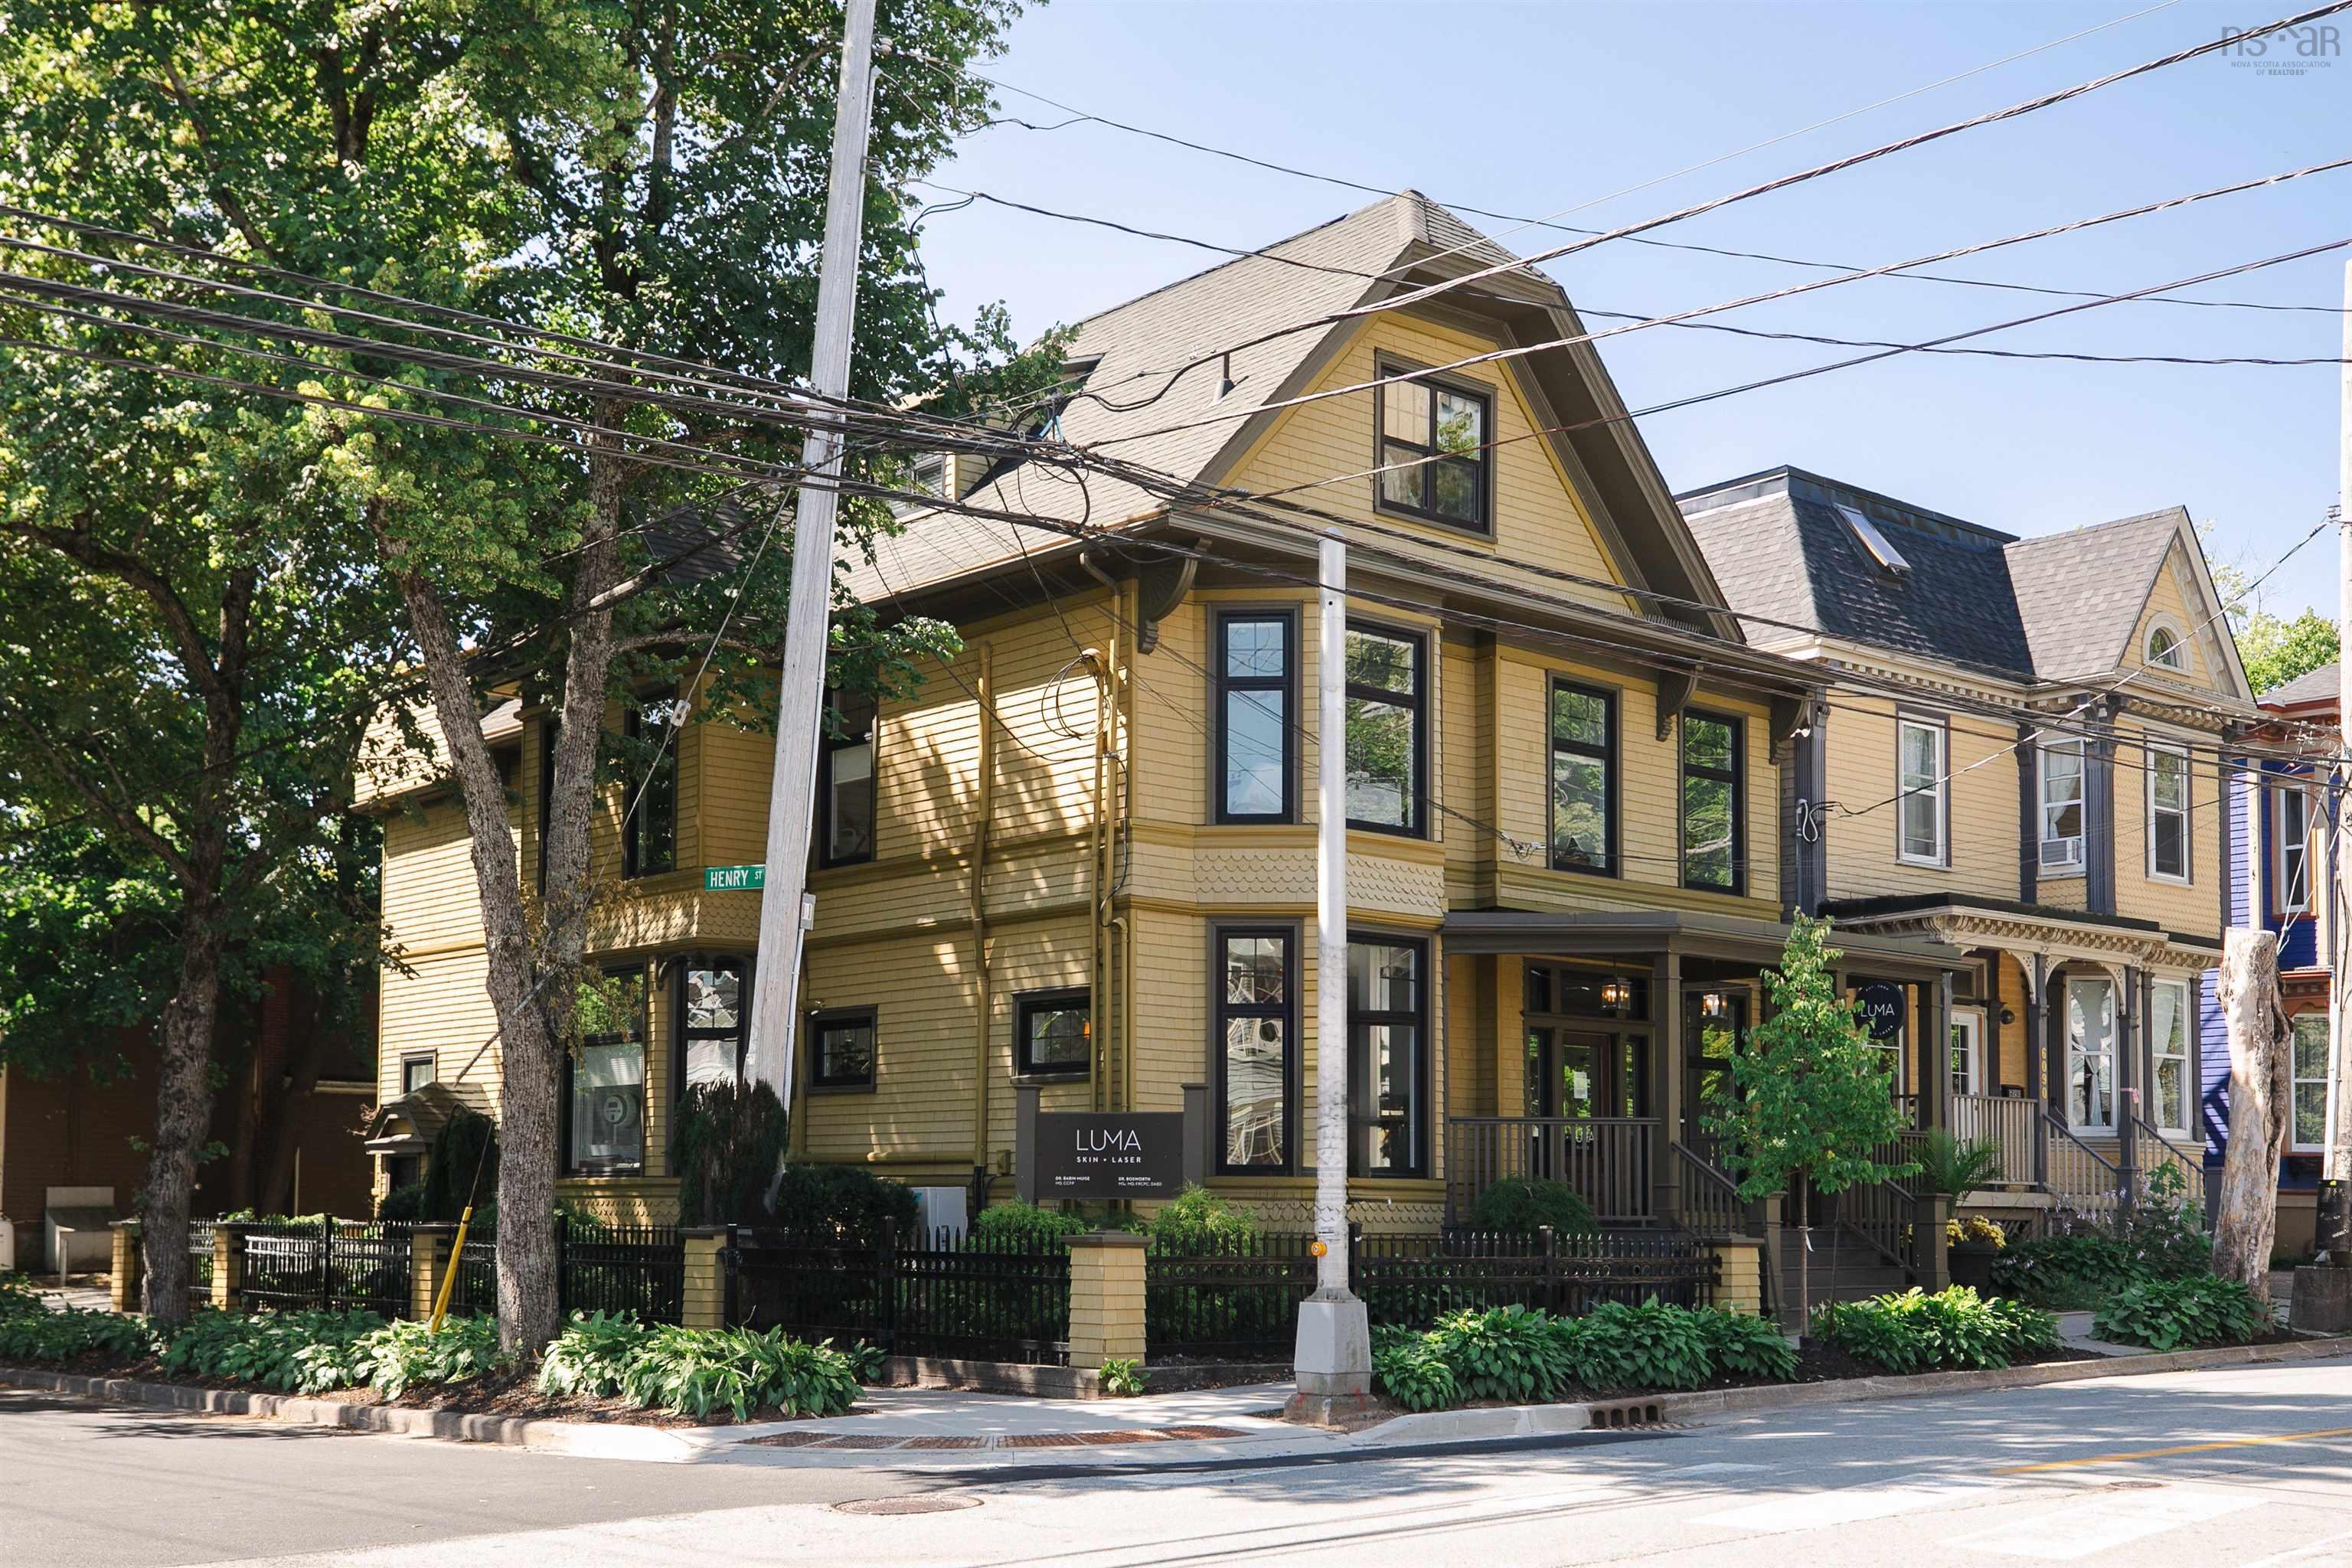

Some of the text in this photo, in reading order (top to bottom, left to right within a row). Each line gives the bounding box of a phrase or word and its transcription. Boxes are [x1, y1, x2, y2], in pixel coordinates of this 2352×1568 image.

[710, 870, 763, 887] HENRY ST
[1860, 1003, 1895, 1018] LUMA
[1076, 1129, 1142, 1152] LUMA
